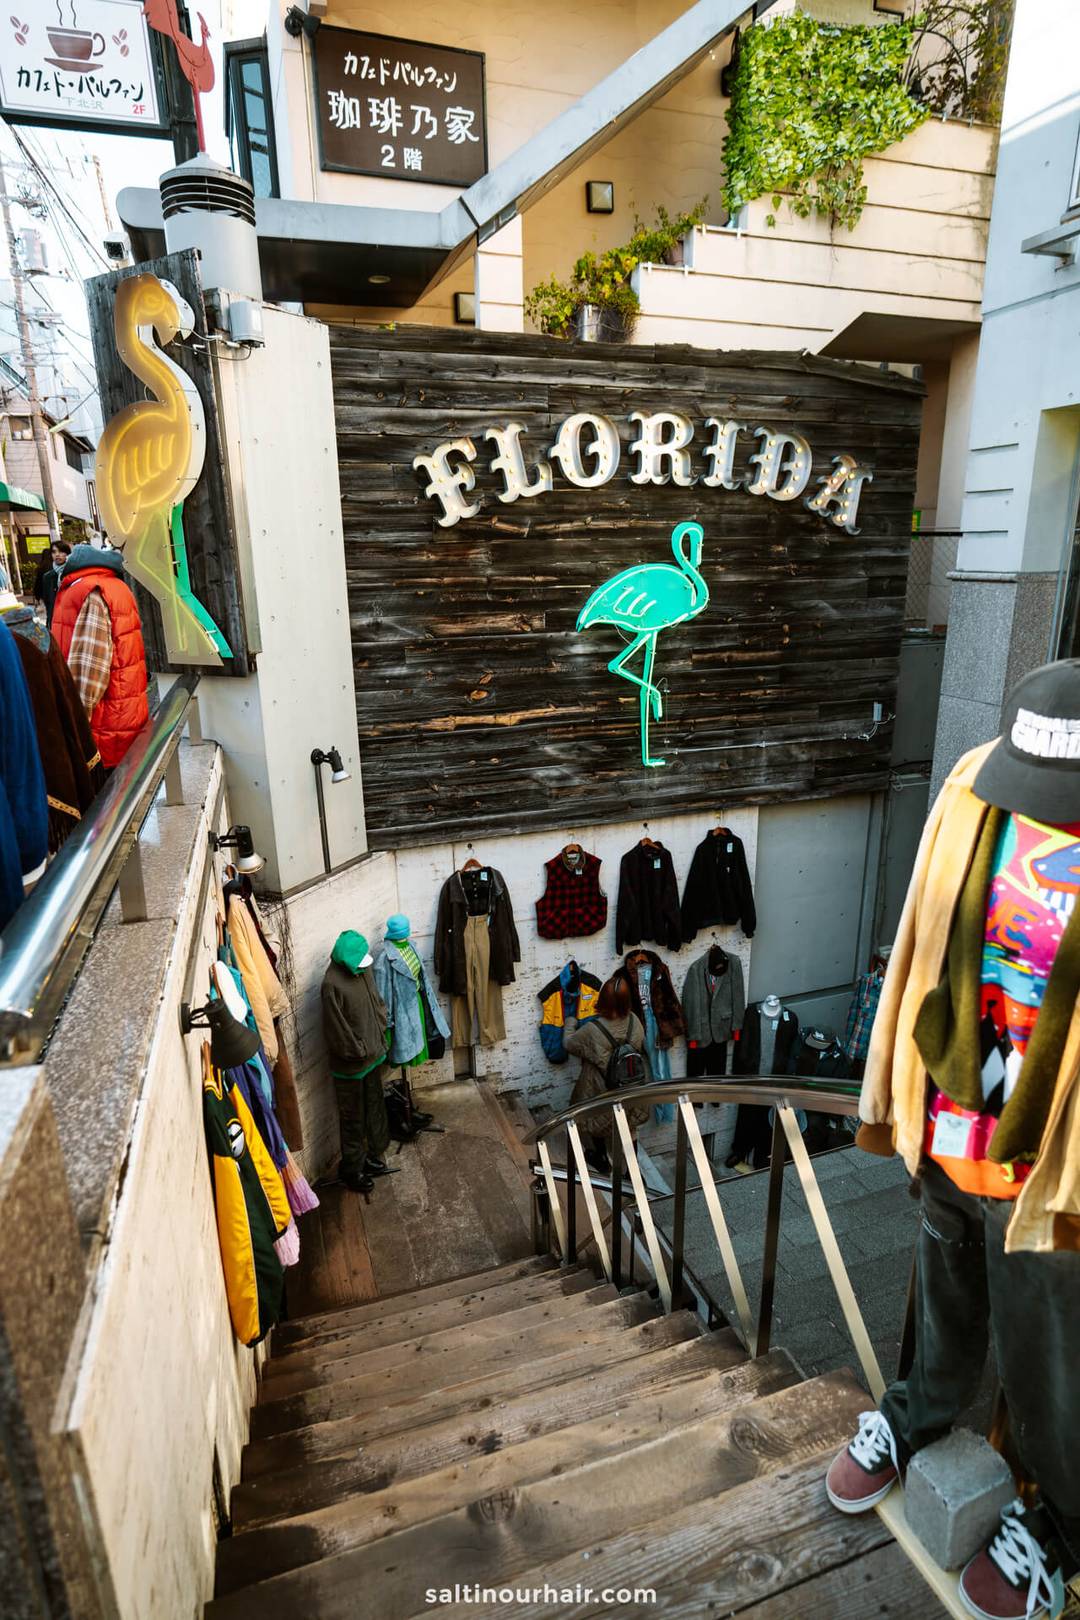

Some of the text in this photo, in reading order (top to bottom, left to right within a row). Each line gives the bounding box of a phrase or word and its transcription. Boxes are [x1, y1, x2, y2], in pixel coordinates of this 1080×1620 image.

[132, 104, 146, 115] 2F
[327, 89, 479, 144] 珈琲乃家
[412, 411, 874, 536] FLORIDA
